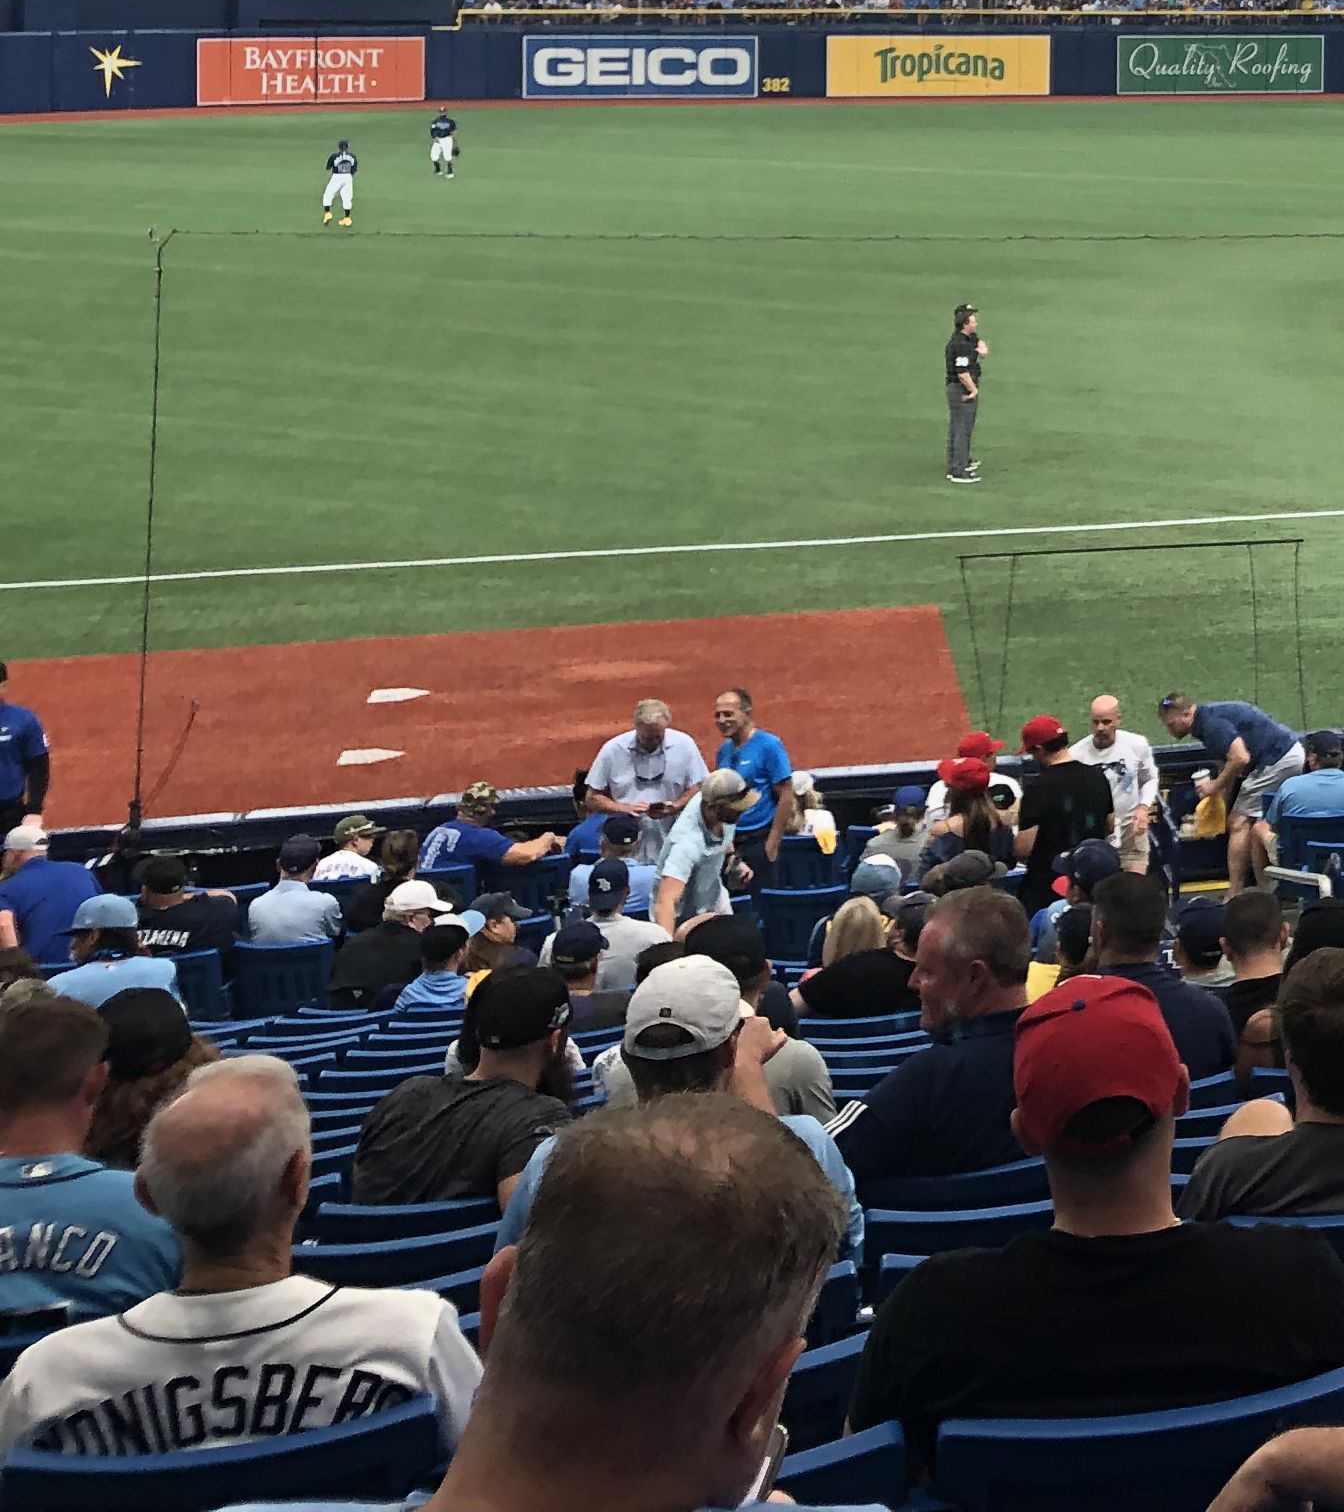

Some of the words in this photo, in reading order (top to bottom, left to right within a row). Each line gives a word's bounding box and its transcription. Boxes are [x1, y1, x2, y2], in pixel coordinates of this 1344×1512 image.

[244, 47, 384, 70] BAYFRONT
[533, 47, 750, 87] GEICO
[874, 44, 1005, 84] Tropicana
[1129, 42, 1216, 85] Quality
[1229, 42, 1312, 84] Roofing
[260, 72, 367, 95] HEALTH
[762, 77, 790, 93] 382
[0, 1223, 119, 1281] ANCO
[32, 1362, 413, 1455] ONIGSBER
